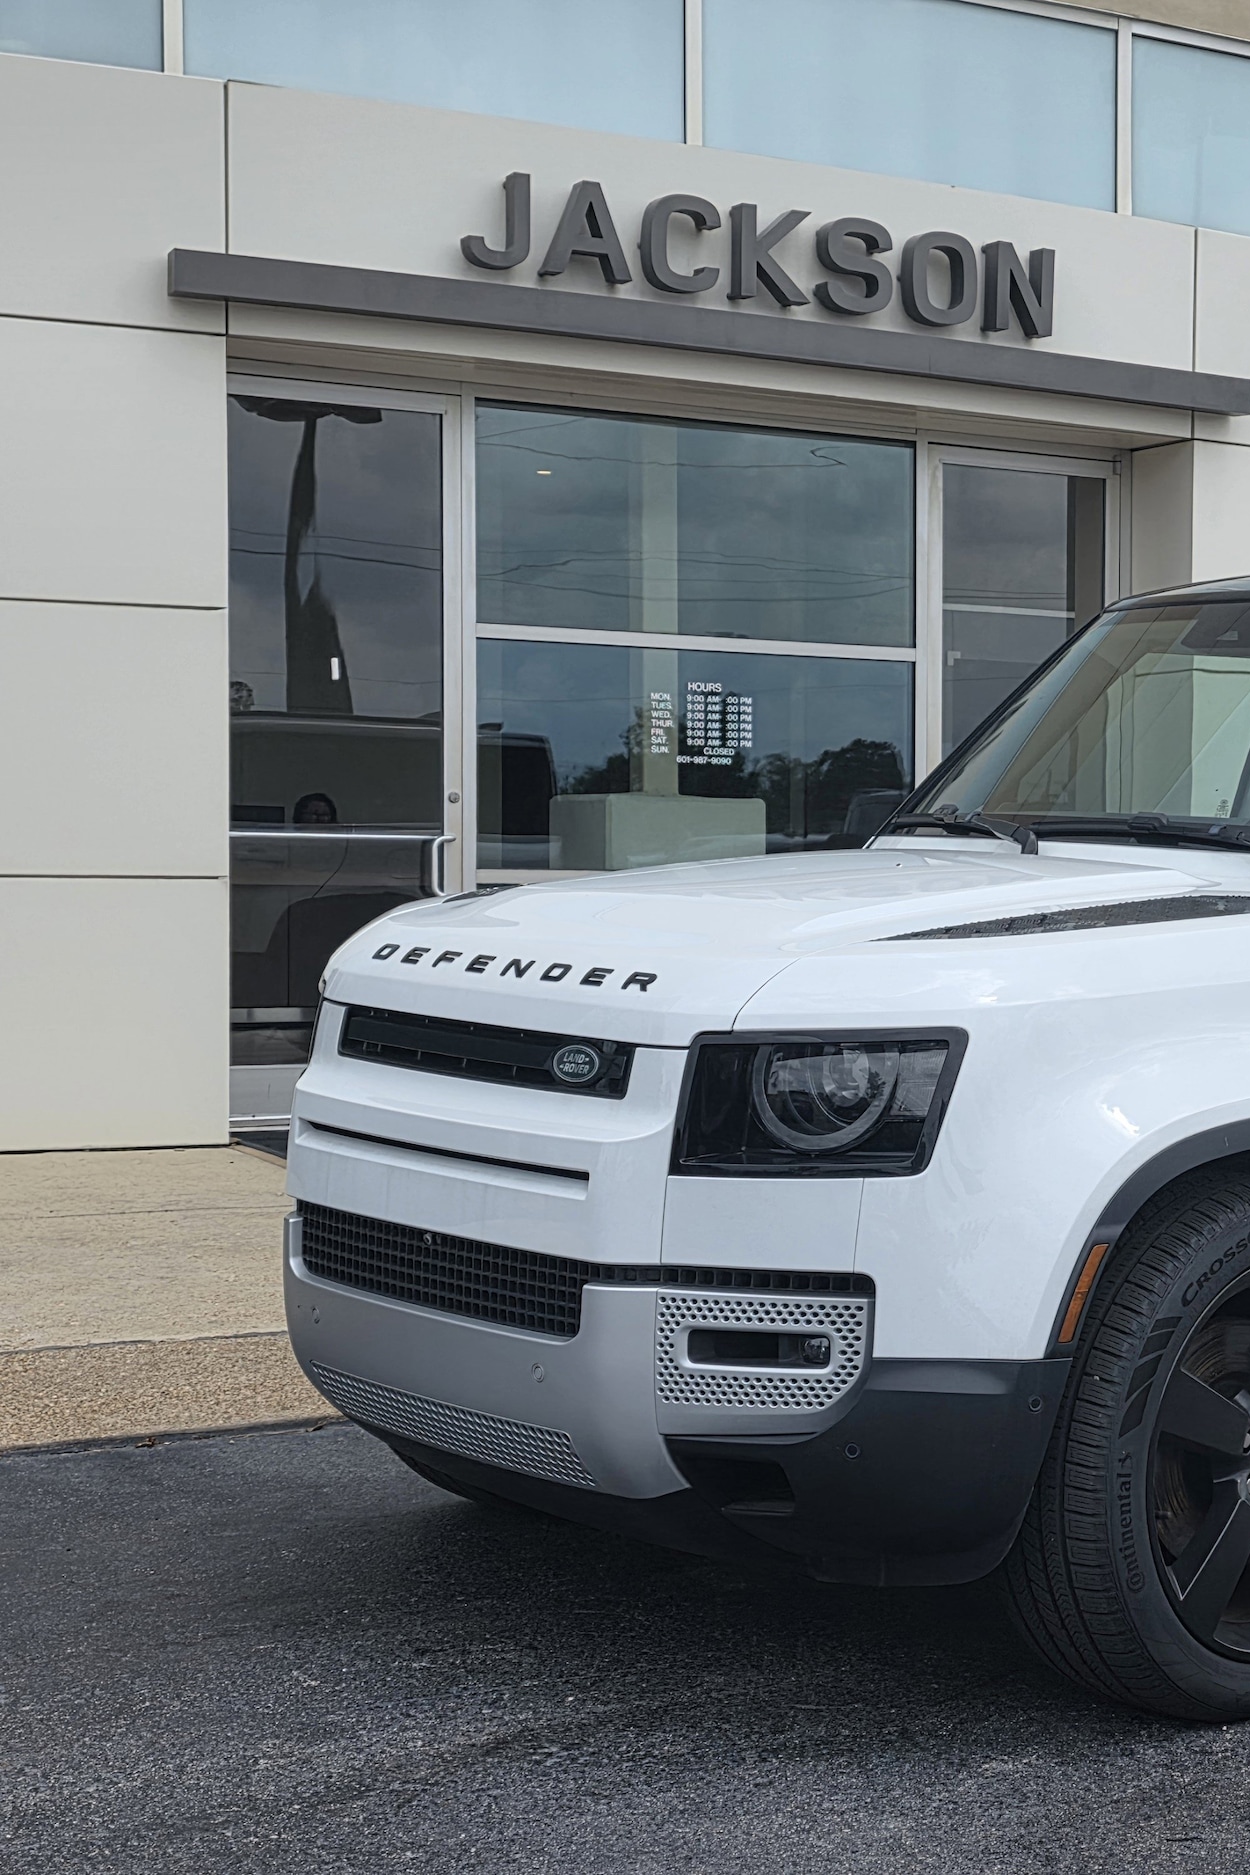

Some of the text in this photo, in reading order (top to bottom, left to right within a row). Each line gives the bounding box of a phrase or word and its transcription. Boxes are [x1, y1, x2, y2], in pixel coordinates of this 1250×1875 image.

[460, 172, 1056, 339] JACKSON
[687, 682, 722, 692] HOURS
[651, 692, 672, 701] MON.
[686, 694, 705, 702] 9:00
[740, 696, 752, 705] PM
[651, 701, 673, 710] TUES.
[686, 703, 705, 711] 9:00
[740, 705, 752, 713] PM
[651, 710, 672, 719] WED.
[686, 712, 705, 720] 9:00
[740, 714, 752, 722] PM
[651, 719, 675, 728] THUR.
[686, 721, 705, 729] 9:00
[740, 723, 752, 731] PM
[686, 729, 705, 737] 9:00
[740, 731, 752, 739] PM
[651, 736, 669, 744] SAT.
[686, 738, 705, 746] 9:00
[740, 740, 752, 748] PM
[651, 744, 735, 756] SUN. CLOSED
[676, 755, 732, 766] 601-987-9090
[371, 943, 658, 992] DEFENDER
[1116, 1471, 1146, 1593] Continental
